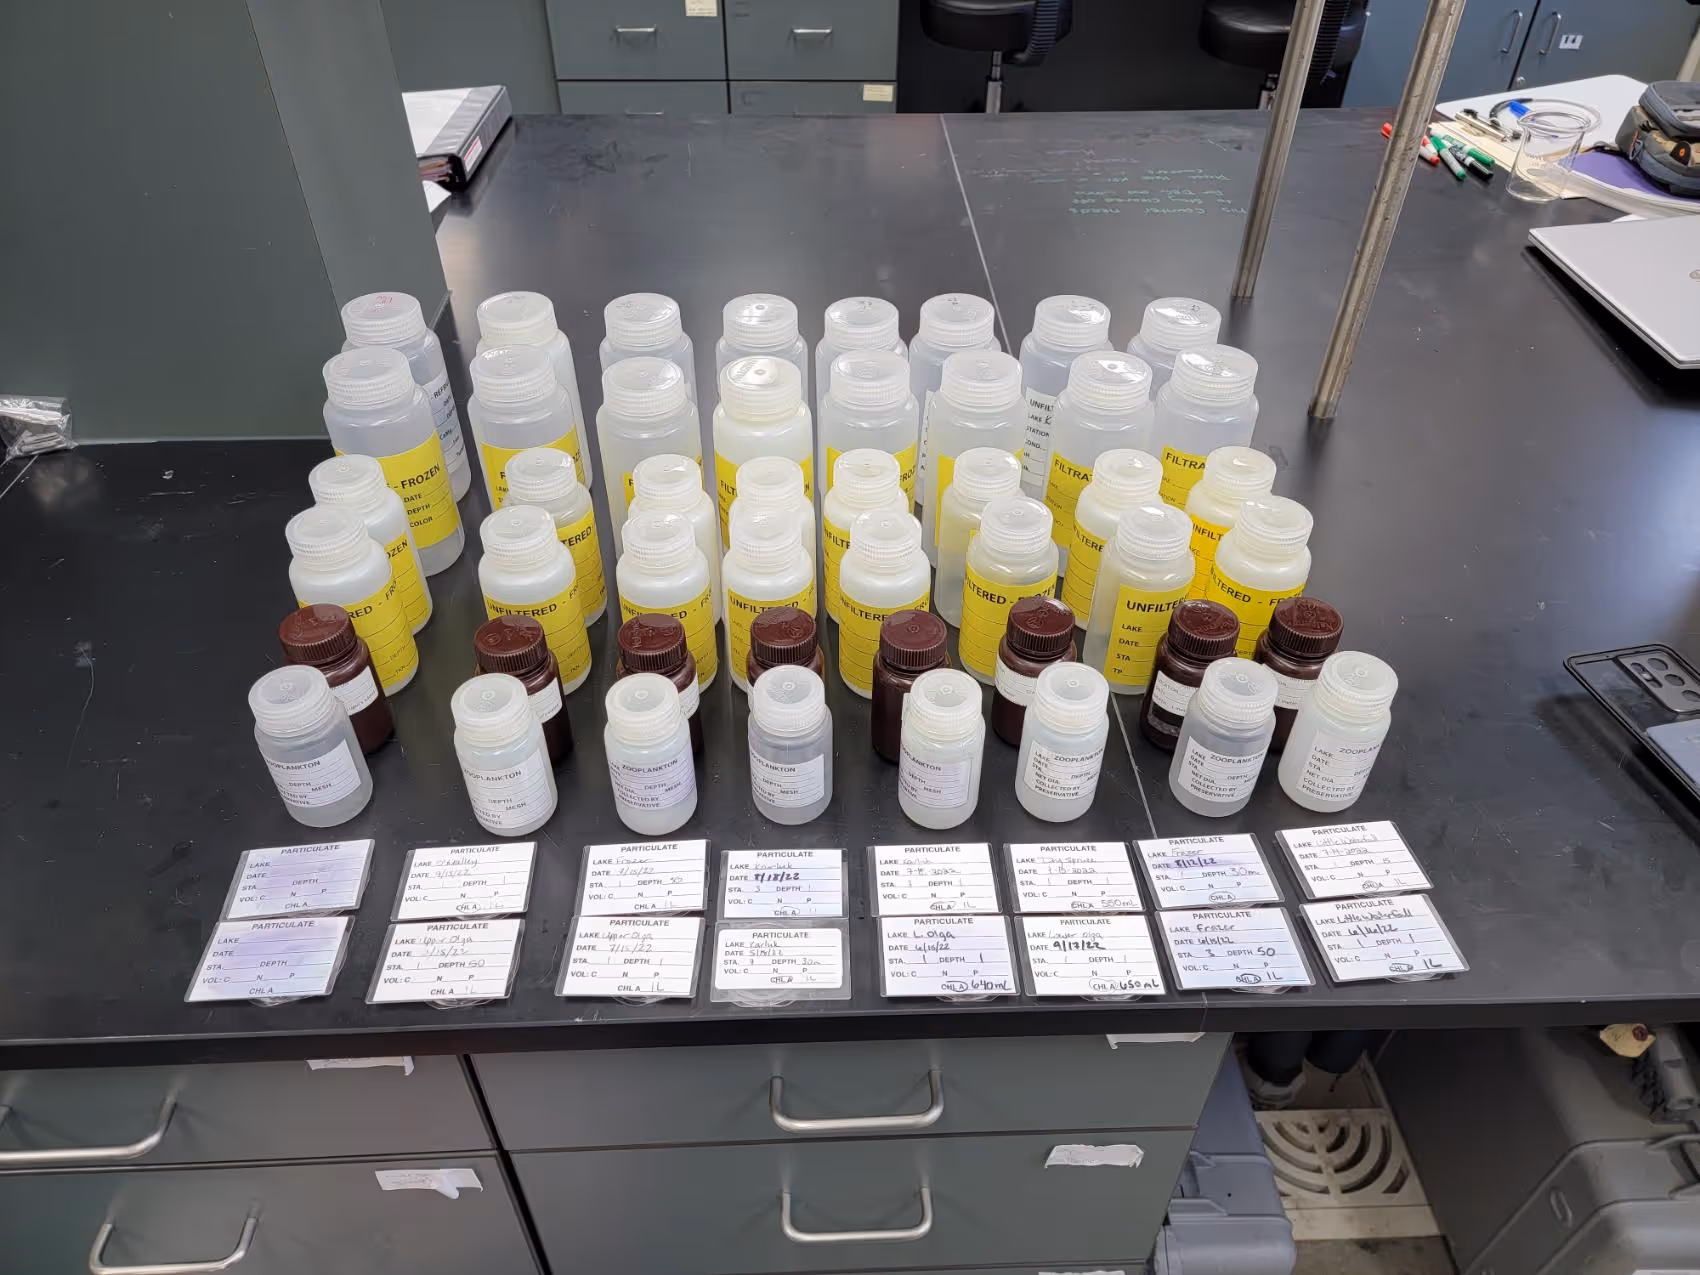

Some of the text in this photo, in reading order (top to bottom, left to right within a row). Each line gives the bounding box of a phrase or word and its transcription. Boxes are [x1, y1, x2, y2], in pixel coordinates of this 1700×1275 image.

[400, 463, 440, 489] FROZEN
[404, 493, 422, 503] DATE
[407, 504, 430, 516] DEPTH
[409, 516, 433, 528] COLOR
[1121, 623, 1143, 633] LAKE
[1118, 638, 1139, 647] DATE
[1116, 653, 1131, 662] STA
[622, 759, 678, 773] ZOOPLANKTON
[1312, 825, 1368, 836] PARTICULATE
[1169, 836, 1224, 846] PARTICULATE
[280, 844, 341, 855] PARTICULATE
[450, 846, 500, 854] PARTICULATE
[620, 844, 678, 853] PARTICULATE
[904, 846, 961, 854] PARTICULATE
[249, 861, 271, 869] LAKE
[1350, 859, 1374, 867] DEPTH
[246, 872, 267, 880] DATE
[292, 878, 319, 886] DEPTH
[1335, 899, 1394, 910] PARTICULATE
[1193, 911, 1252, 920] PARTICULATE
[251, 920, 316, 931] PARTICULATE
[609, 919, 669, 927] PARTICULATE
[914, 918, 974, 926] PARTICULATE
[1315, 918, 1336, 926] LAKE
[426, 922, 489, 932] PARTICULATE
[927, 930, 956, 941] Olga
[217, 937, 240, 945] LAKE
[1376, 938, 1401, 946] DEPTH
[1257, 947, 1275, 957] 50
[259, 960, 288, 968] DEPTH
